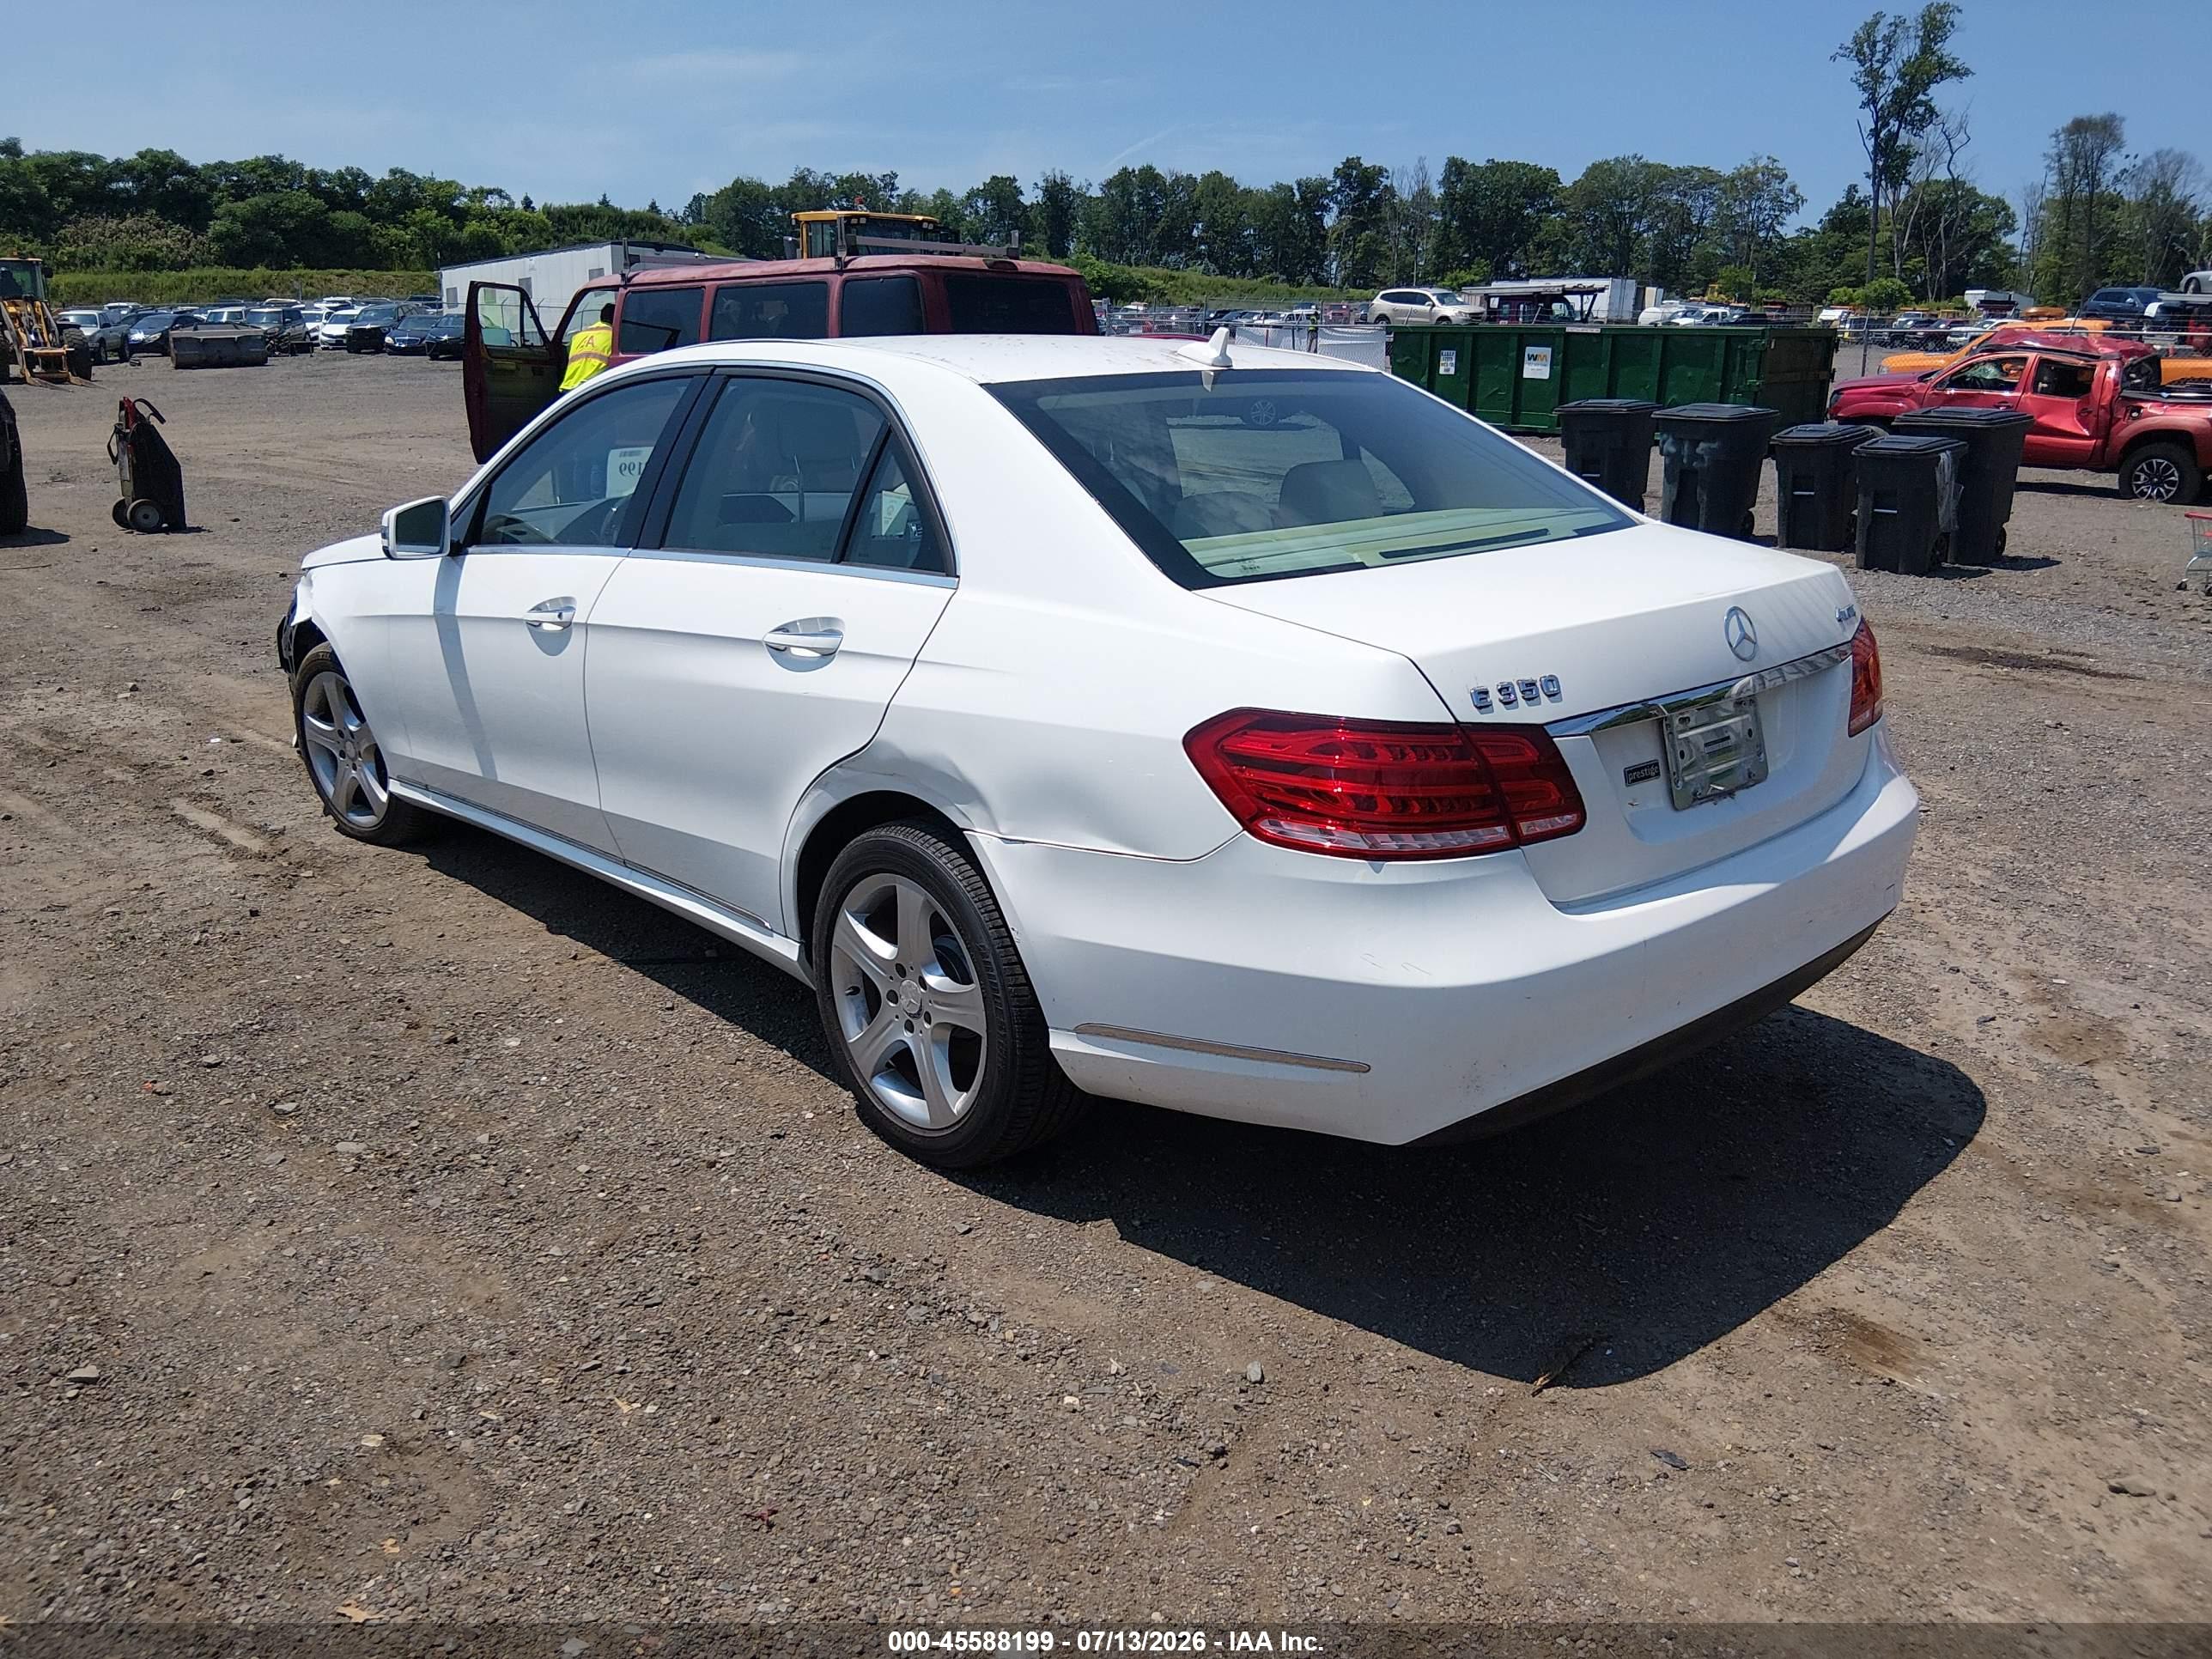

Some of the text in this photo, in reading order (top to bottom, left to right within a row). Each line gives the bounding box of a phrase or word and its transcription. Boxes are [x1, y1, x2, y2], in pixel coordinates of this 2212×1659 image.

[1527, 352, 1548, 362] WM
[1469, 674, 1561, 709] E 350
[1628, 764, 1659, 783] prestige
